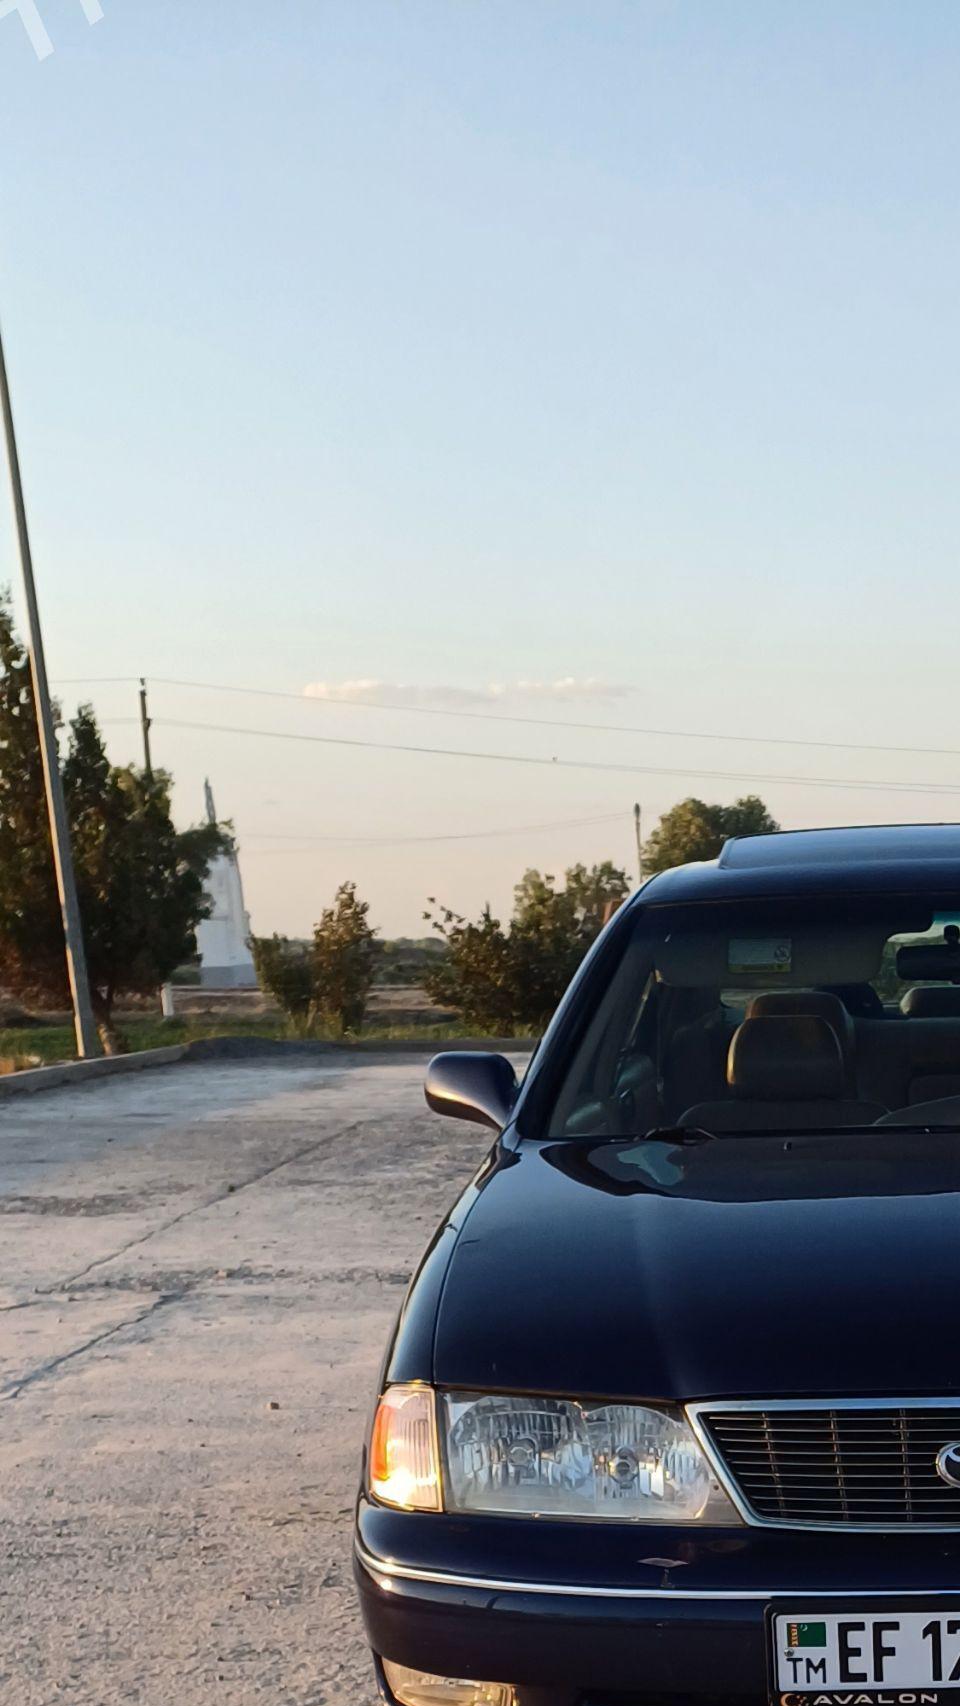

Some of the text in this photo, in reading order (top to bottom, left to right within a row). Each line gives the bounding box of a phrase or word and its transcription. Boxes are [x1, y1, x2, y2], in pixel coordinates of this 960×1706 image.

[837, 1621, 900, 1683] EF
[786, 1657, 827, 1685] TM
[813, 1692, 939, 1706] AVALON
